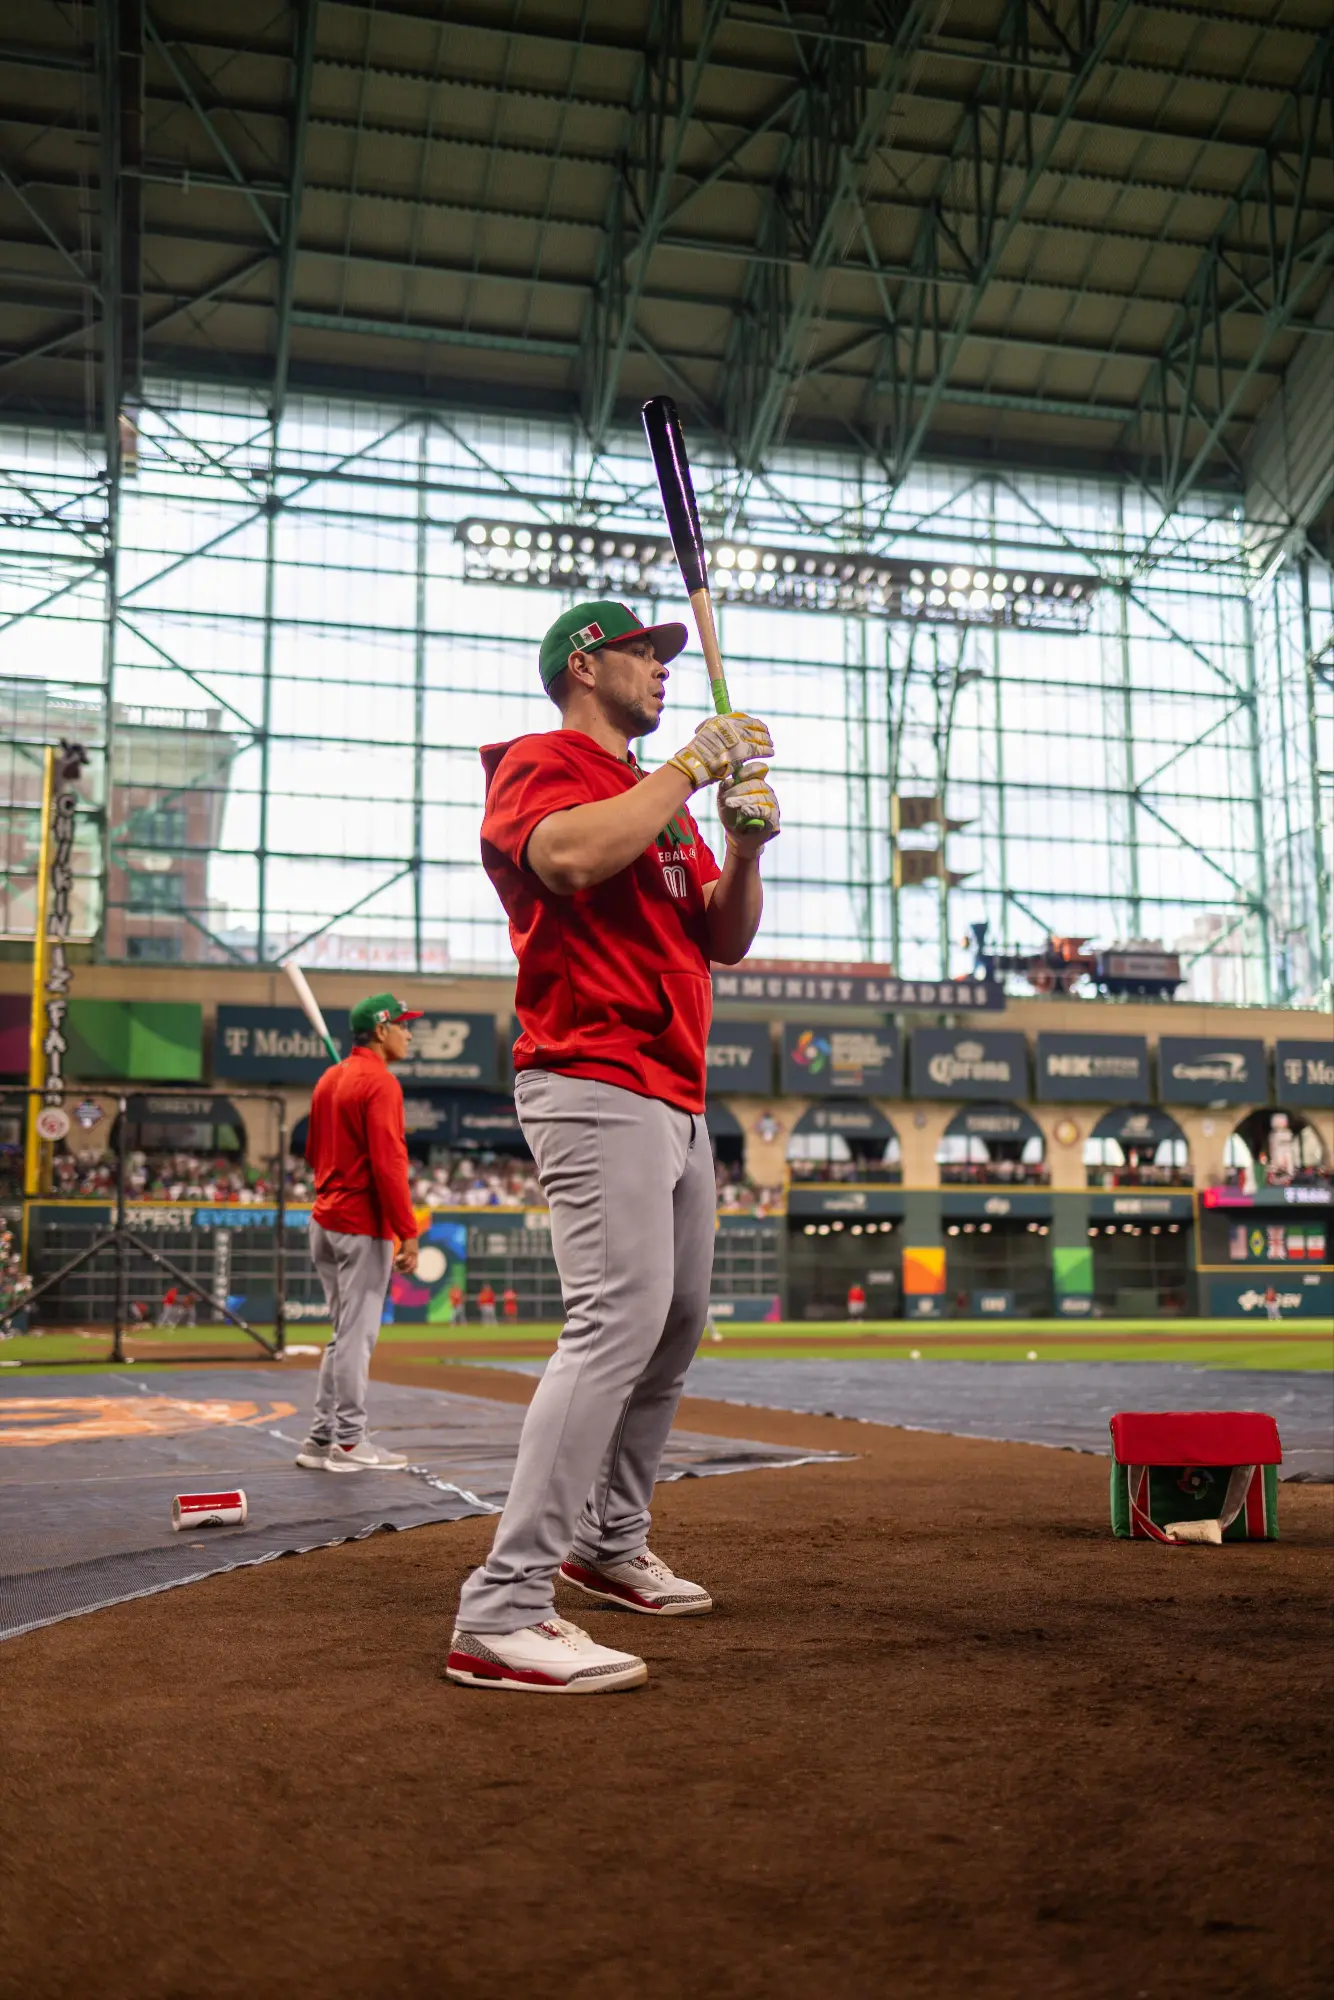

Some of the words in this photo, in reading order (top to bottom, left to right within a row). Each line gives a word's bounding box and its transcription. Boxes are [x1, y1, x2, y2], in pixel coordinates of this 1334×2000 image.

[714, 975, 853, 998] MMUNITY
[865, 981, 988, 1005] LEADERS
[705, 1045, 753, 1068] ECTV
